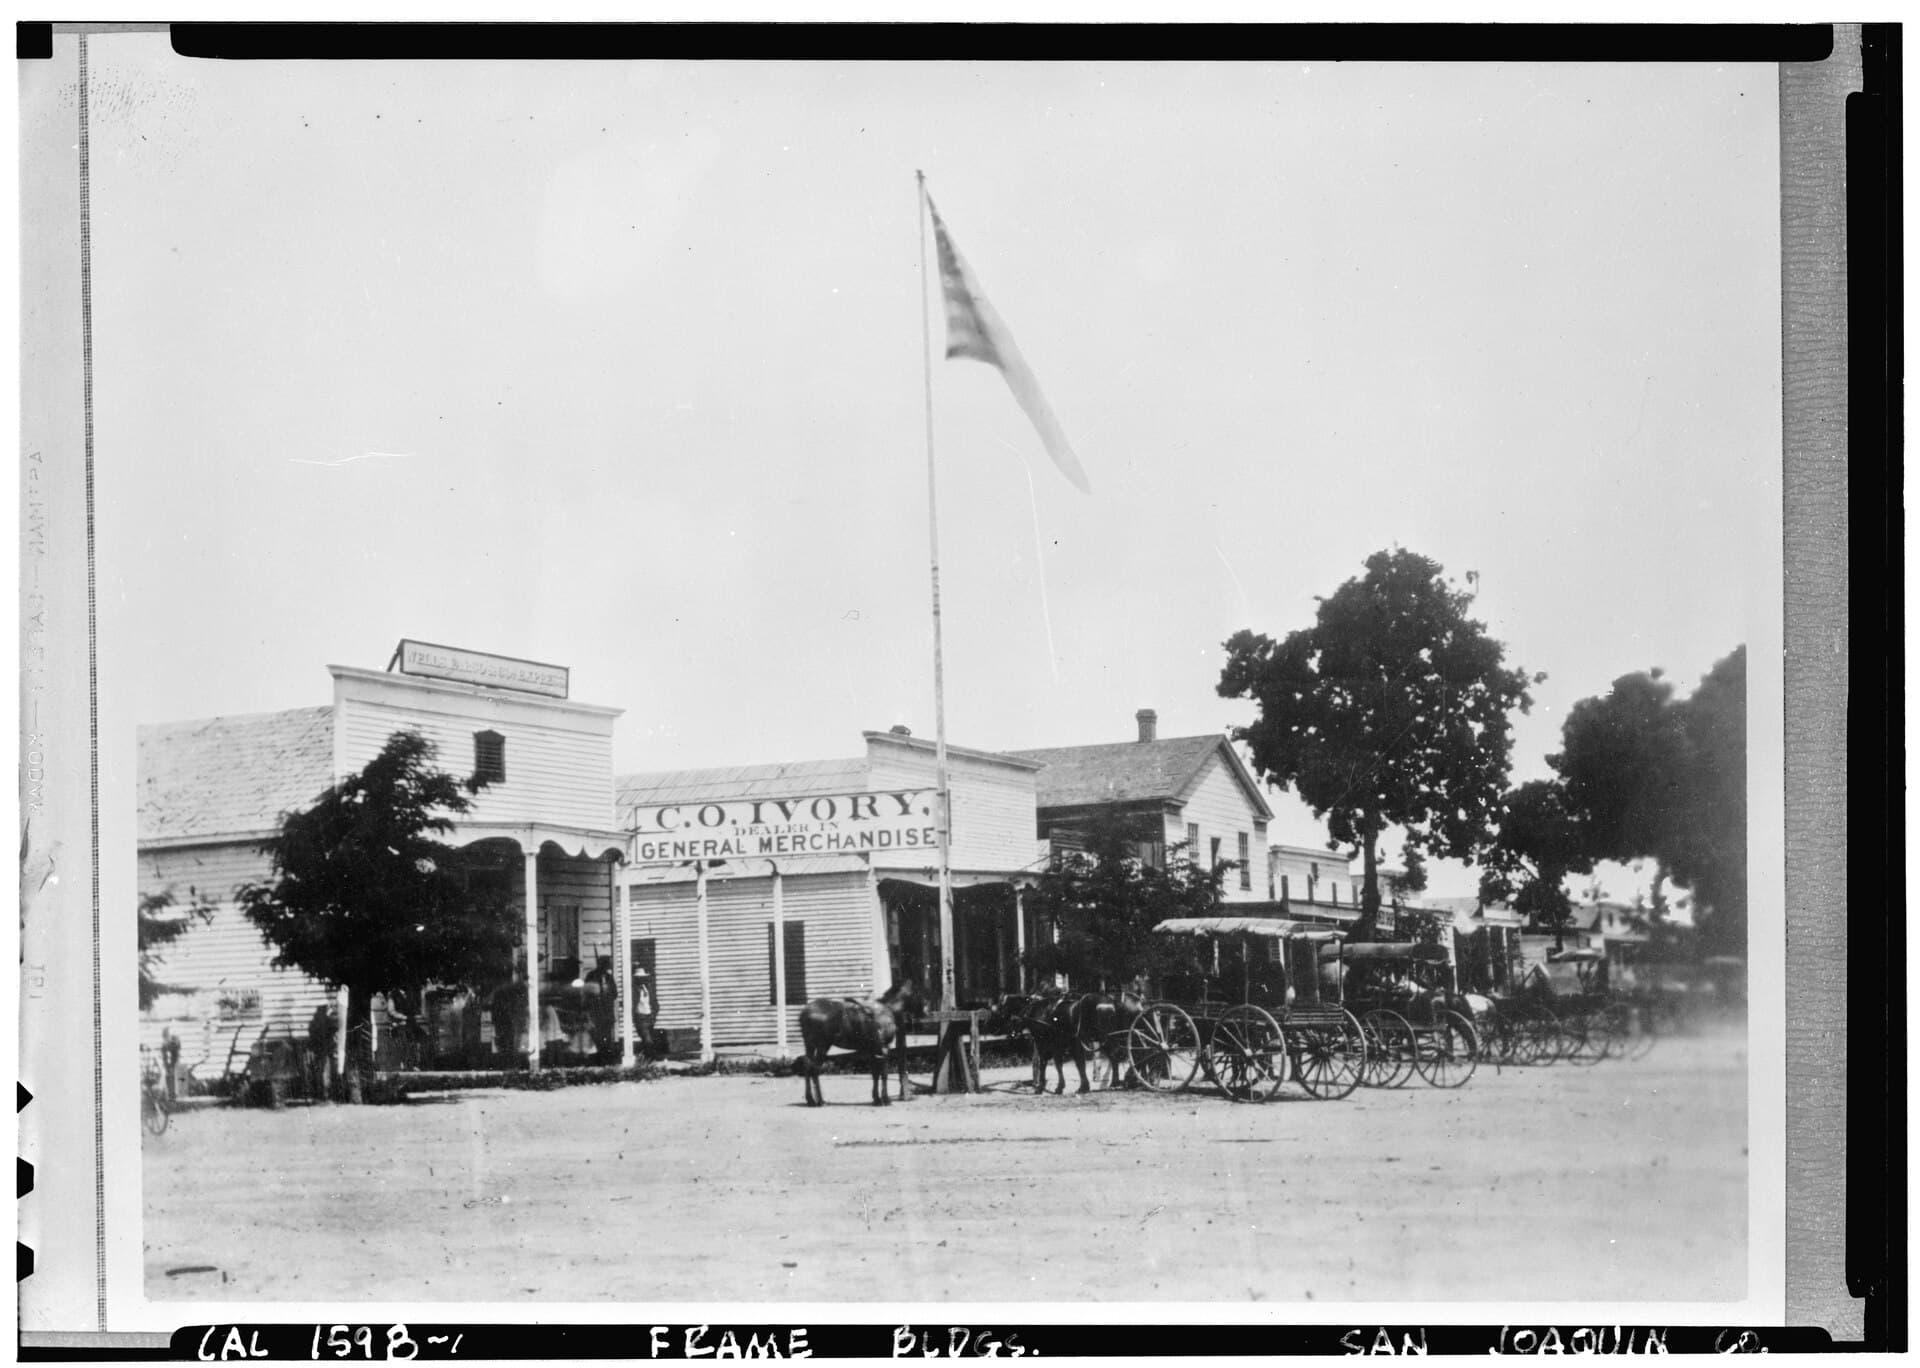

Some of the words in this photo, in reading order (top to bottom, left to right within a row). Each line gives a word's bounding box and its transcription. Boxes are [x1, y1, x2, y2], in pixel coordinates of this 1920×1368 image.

[751, 791, 931, 824] IVORY.
[640, 836, 746, 861] GENERAL
[758, 826, 937, 854] MERCHANDISE
[733, 822, 809, 837] DEALER
[818, 820, 840, 832] IN
